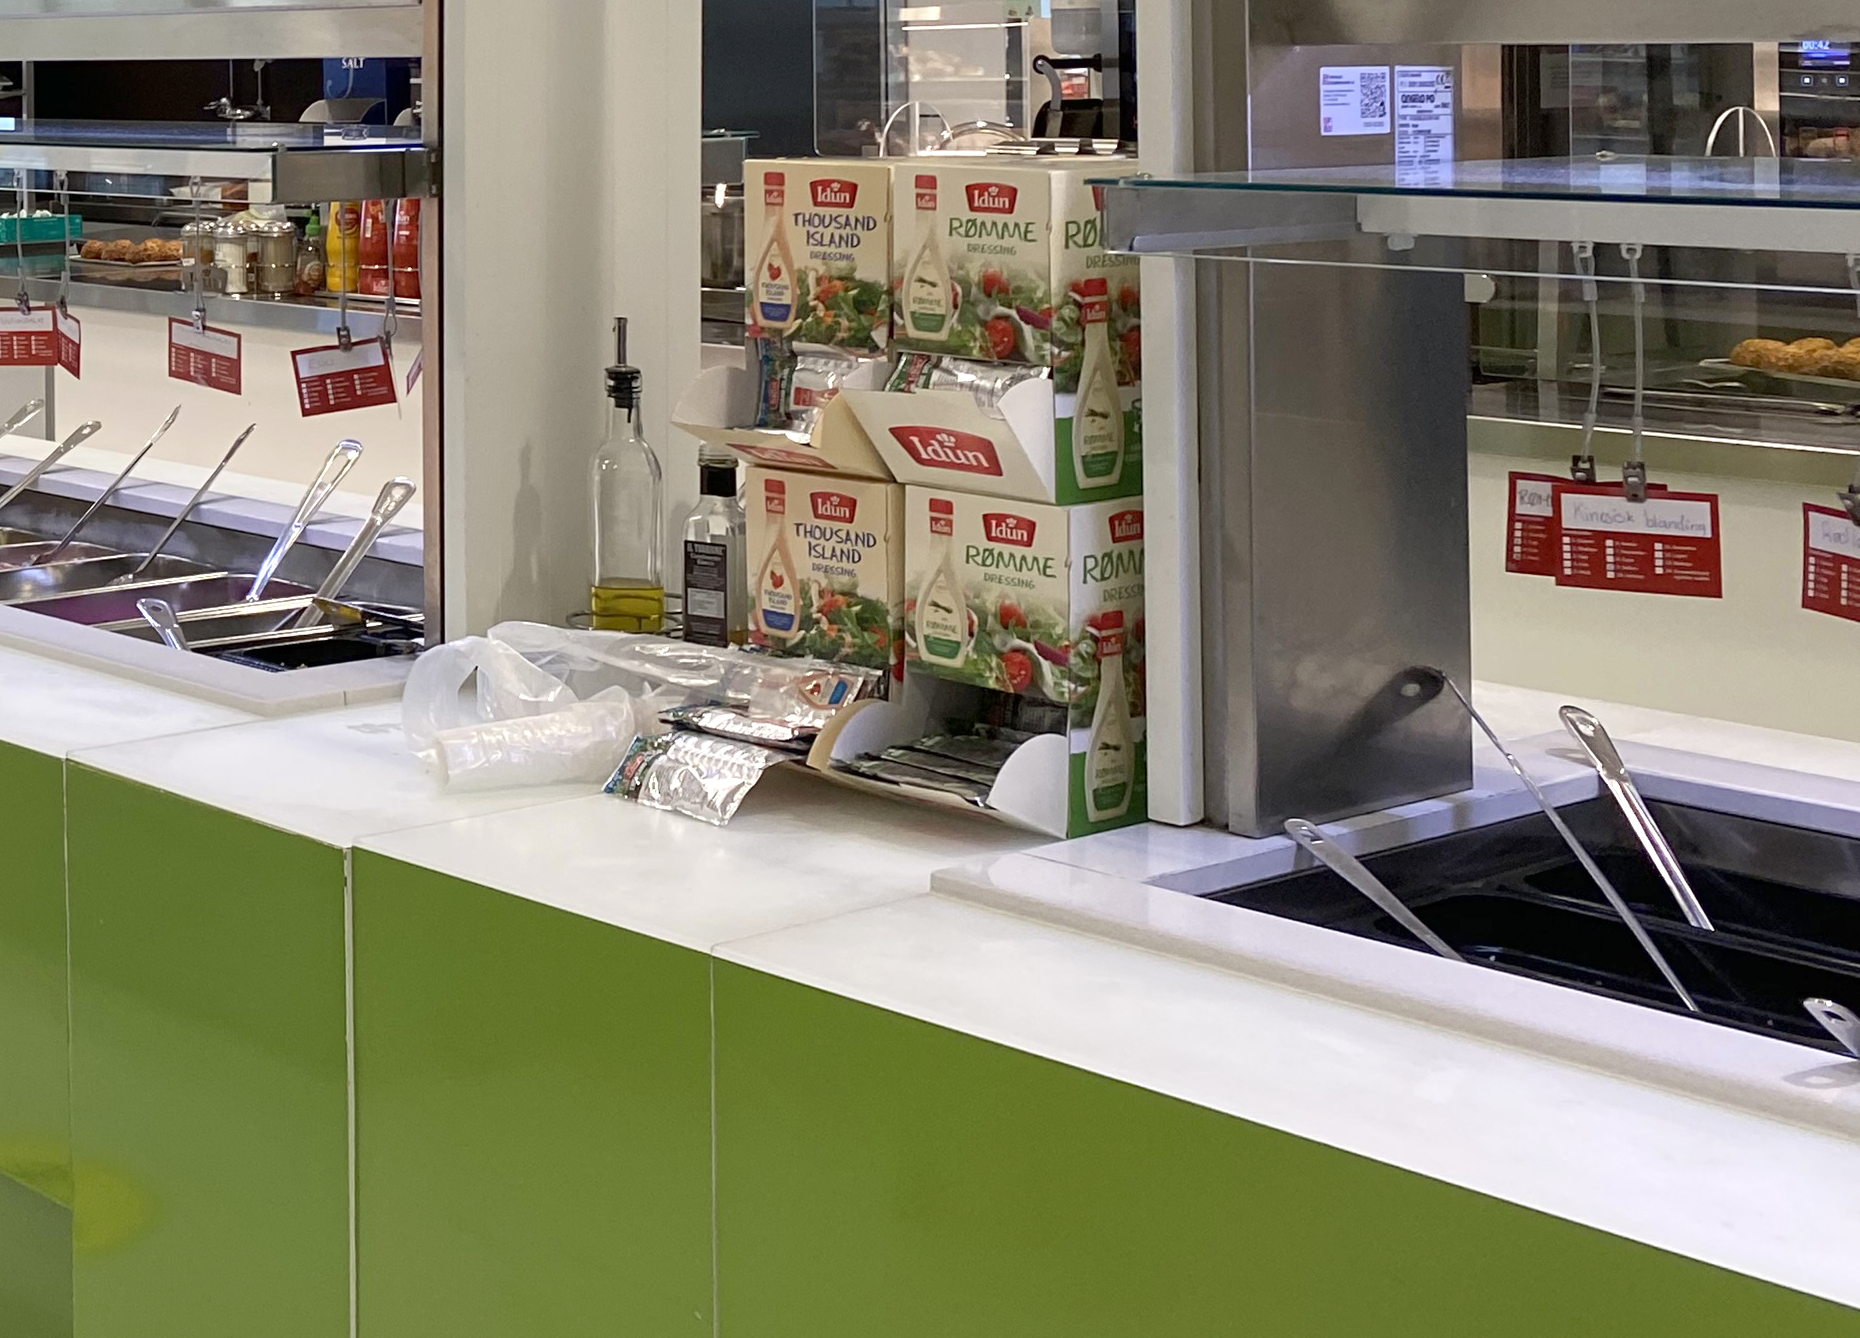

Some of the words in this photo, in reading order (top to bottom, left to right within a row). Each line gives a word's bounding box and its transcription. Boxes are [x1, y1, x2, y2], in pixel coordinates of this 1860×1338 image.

[341, 57, 365, 69] SALT
[817, 185, 850, 204] Idun
[973, 189, 1010, 209] Idun
[793, 212, 877, 232] THOUSAND
[948, 217, 1038, 243] RØMME
[806, 230, 861, 249] ISLAND
[967, 243, 1018, 256] DRESSING
[809, 251, 856, 263] DRESSING
[909, 435, 990, 468] Idun
[817, 498, 850, 519] Idun
[794, 522, 878, 549] THOUSAND
[990, 519, 1028, 542] Idun
[1114, 519, 1142, 539] Idun
[807, 541, 862, 564] ISLAND
[965, 544, 1058, 579] RØMME
[811, 562, 857, 579] DRESSING
[1082, 548, 1145, 585] RØM
[983, 572, 1036, 590] DRESSING
